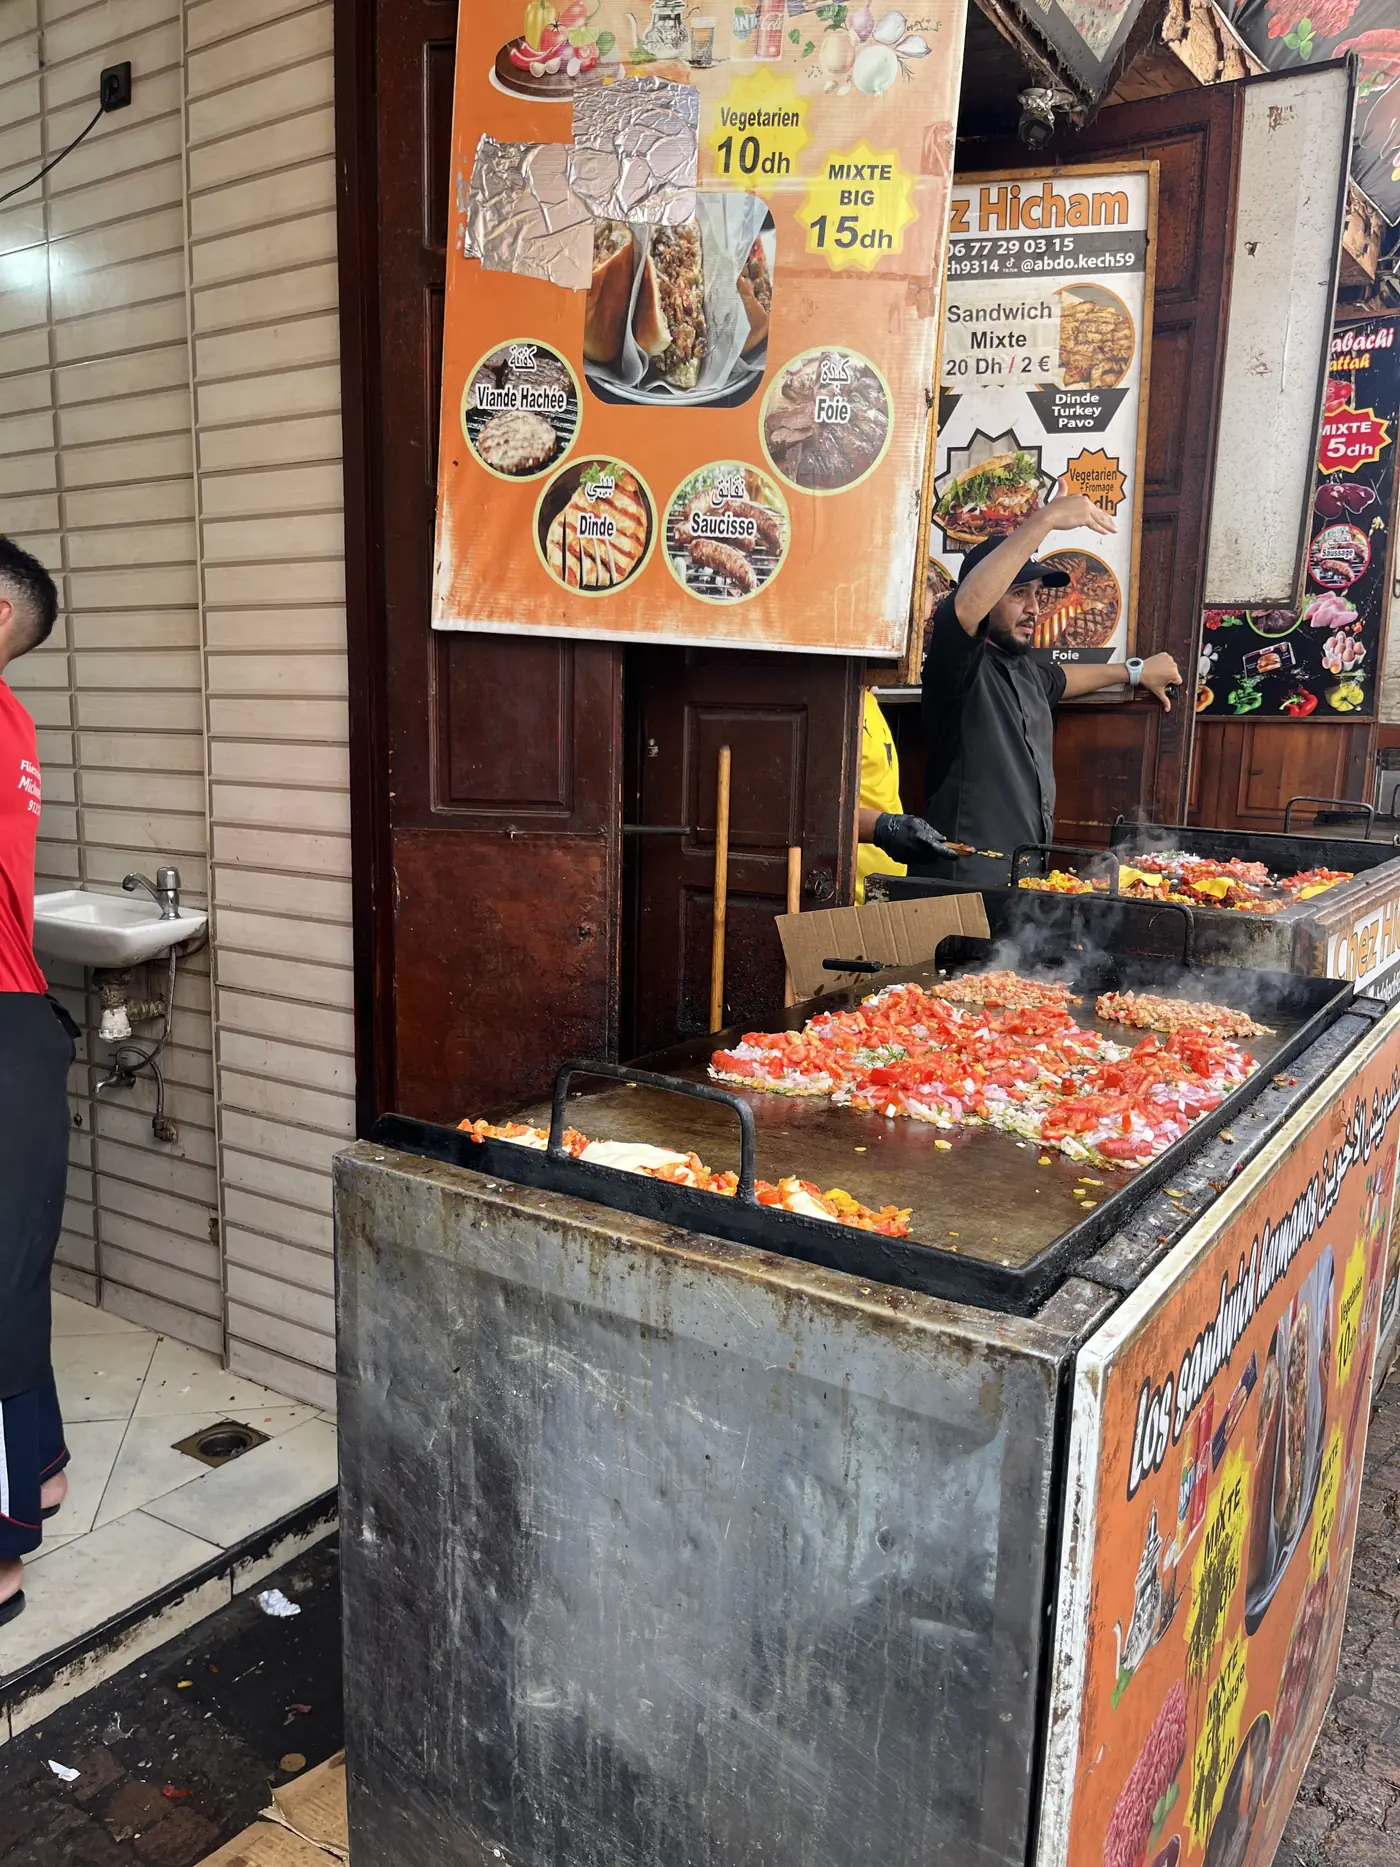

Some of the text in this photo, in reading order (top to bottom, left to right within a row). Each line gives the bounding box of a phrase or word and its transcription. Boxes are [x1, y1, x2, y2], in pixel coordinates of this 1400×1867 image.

[720, 106, 799, 131] Vegetarien
[717, 136, 790, 174] 10dh
[828, 164, 892, 180] MIXTE
[839, 190, 875, 206] BIG
[978, 183, 1128, 232] Hicham
[810, 215, 893, 249] 15dh
[970, 242, 992, 256] 77
[997, 240, 1020, 254] 29
[1024, 239, 1047, 252] 03
[1052, 237, 1074, 251] 15
[1021, 252, 1135, 271] @abdo.kech59
[947, 301, 1052, 323] Sandwich
[970, 331, 1027, 349] Mixte
[945, 355, 1050, 376] 20 Dh / 2 €
[478, 386, 566, 410] Viande Hachée
[1055, 393, 1100, 404] Dinde
[817, 398, 848, 422] Foie
[1052, 406, 1102, 418] Turkey
[1058, 418, 1094, 428] Pavo
[1070, 467, 1117, 484] Vegetarien
[1085, 482, 1114, 494] Fromage
[580, 515, 614, 537] Dinde
[692, 512, 755, 536] Saucisse
[1322, 549, 1354, 559] Saussage
[1052, 650, 1079, 660] Foie
[1333, 897, 1400, 981] Chez Hi
[1128, 1374, 1173, 1501] Los
[1173, 1234, 1258, 1446] sandwich
